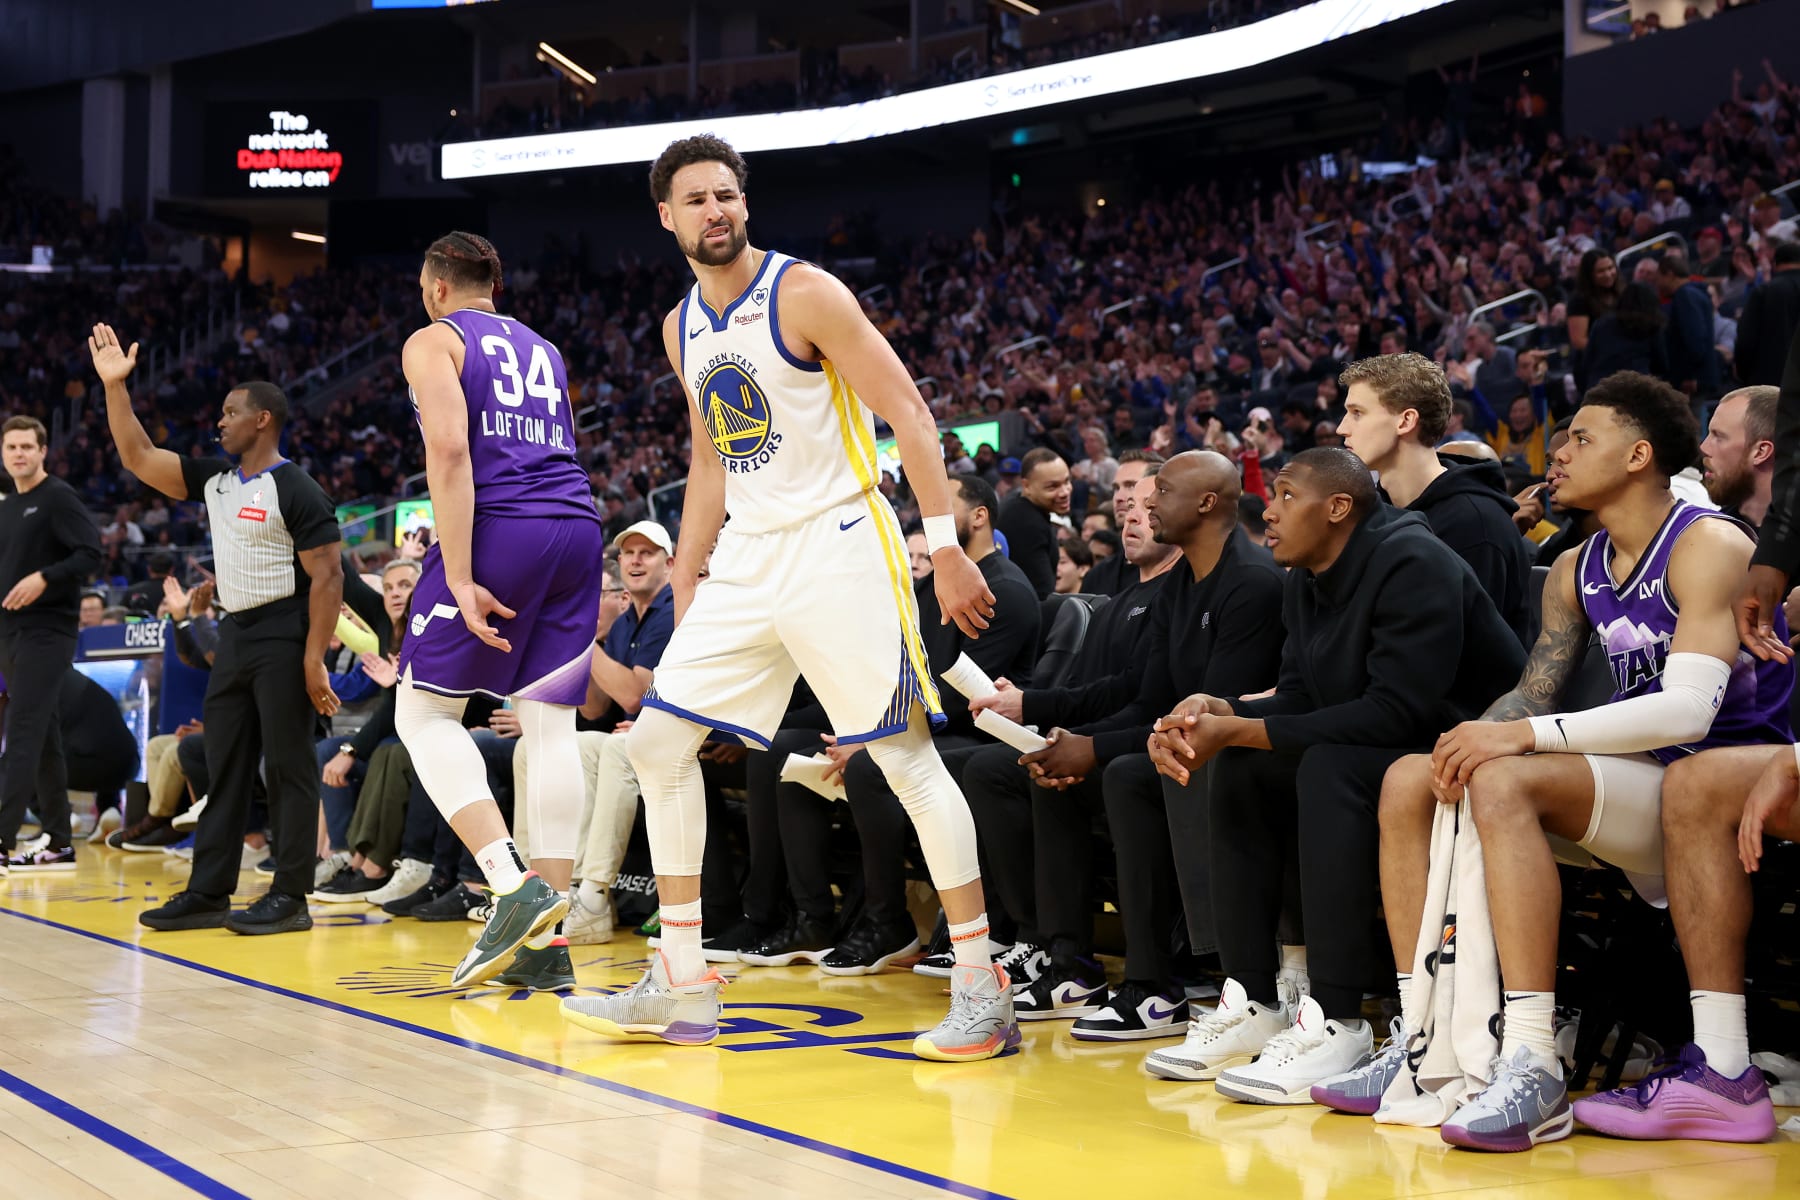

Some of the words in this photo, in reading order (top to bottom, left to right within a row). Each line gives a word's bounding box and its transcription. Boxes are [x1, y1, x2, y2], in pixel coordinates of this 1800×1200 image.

[269, 111, 308, 131] The
[248, 129, 329, 150] network
[237, 149, 278, 169] Dub
[278, 149, 342, 169] Nation
[249, 168, 303, 188] relies
[303, 170, 330, 187] on
[734, 312, 764, 325] Rakuten
[481, 335, 562, 416] 34
[694, 351, 728, 389] GOLDEN
[731, 352, 758, 378] STATE
[740, 383, 753, 409] 11
[481, 411, 545, 445] LOFTON
[549, 422, 570, 450] JR.
[718, 432, 783, 473] ARRIORS
[125, 622, 159, 647] CHASE
